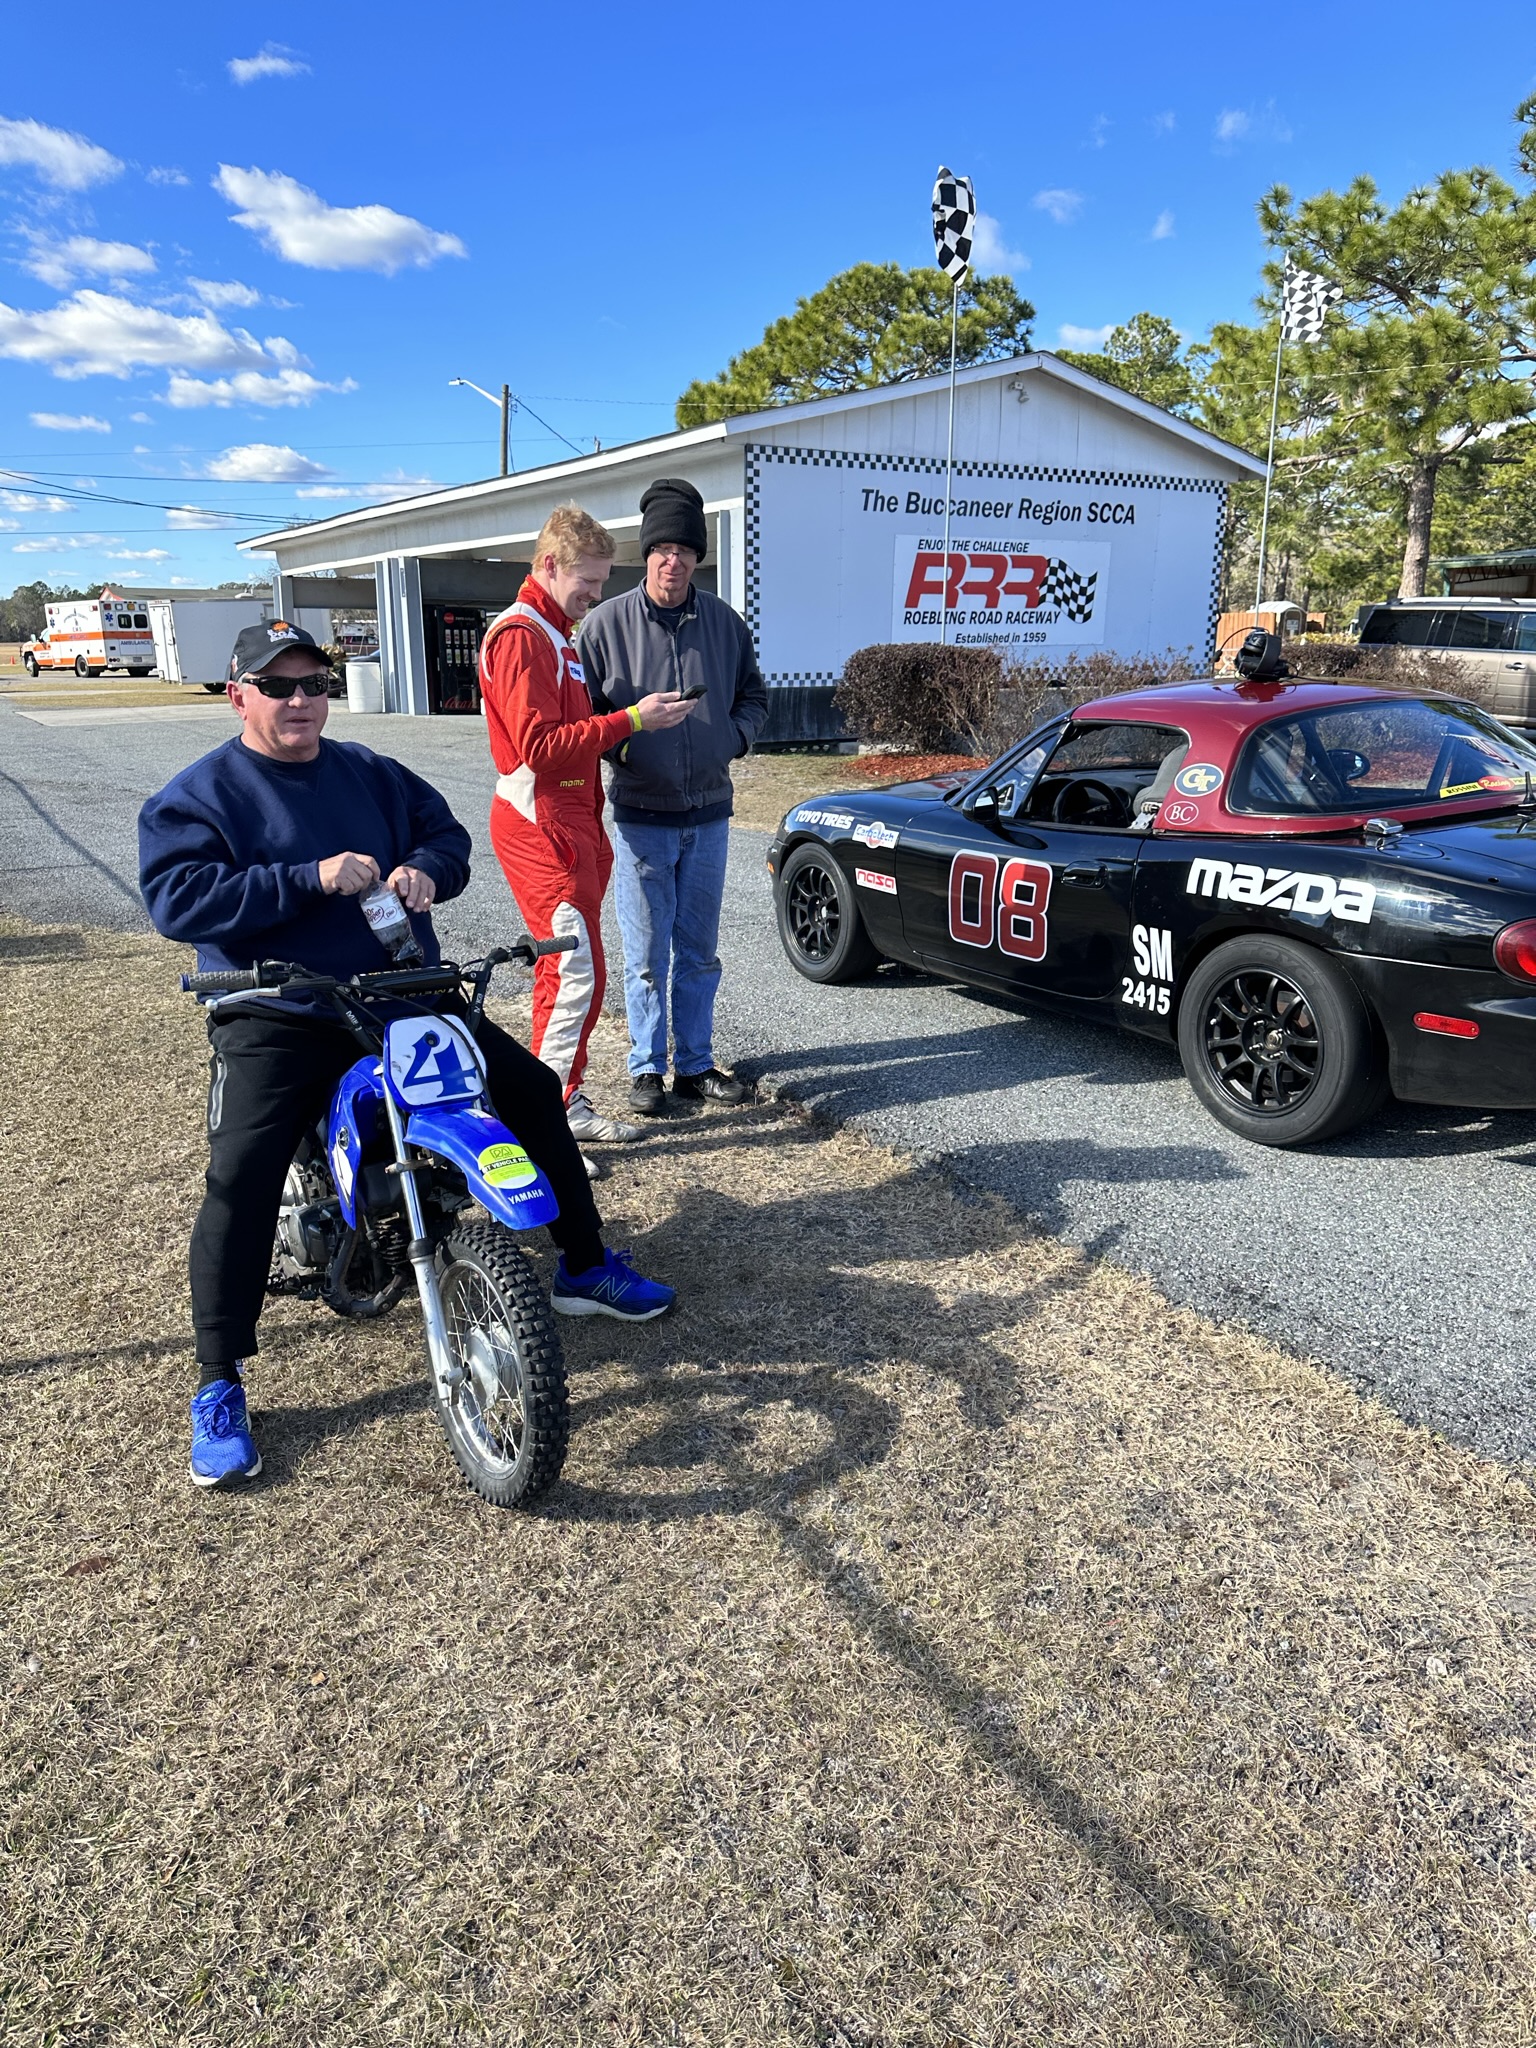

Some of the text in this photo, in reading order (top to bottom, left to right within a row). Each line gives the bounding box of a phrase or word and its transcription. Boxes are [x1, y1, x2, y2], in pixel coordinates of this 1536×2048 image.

[861, 488, 1135, 526] The Buccaneer Region SCCA
[951, 540, 971, 552] THE
[972, 540, 1030, 553] CHALLENGE
[903, 610, 1061, 625] ROEBLING ROAD RACEWAY
[955, 632, 1047, 645] Established in 1959
[1182, 768, 1217, 792] GT
[795, 809, 855, 830] TOYO TIRES
[1169, 805, 1194, 822] BC
[949, 849, 1053, 962] 08
[1132, 924, 1174, 982] SM
[1121, 977, 1171, 1016] 2415
[491, 1158, 518, 1169] VEHICLE
[507, 1188, 545, 1205] YAMAHA
